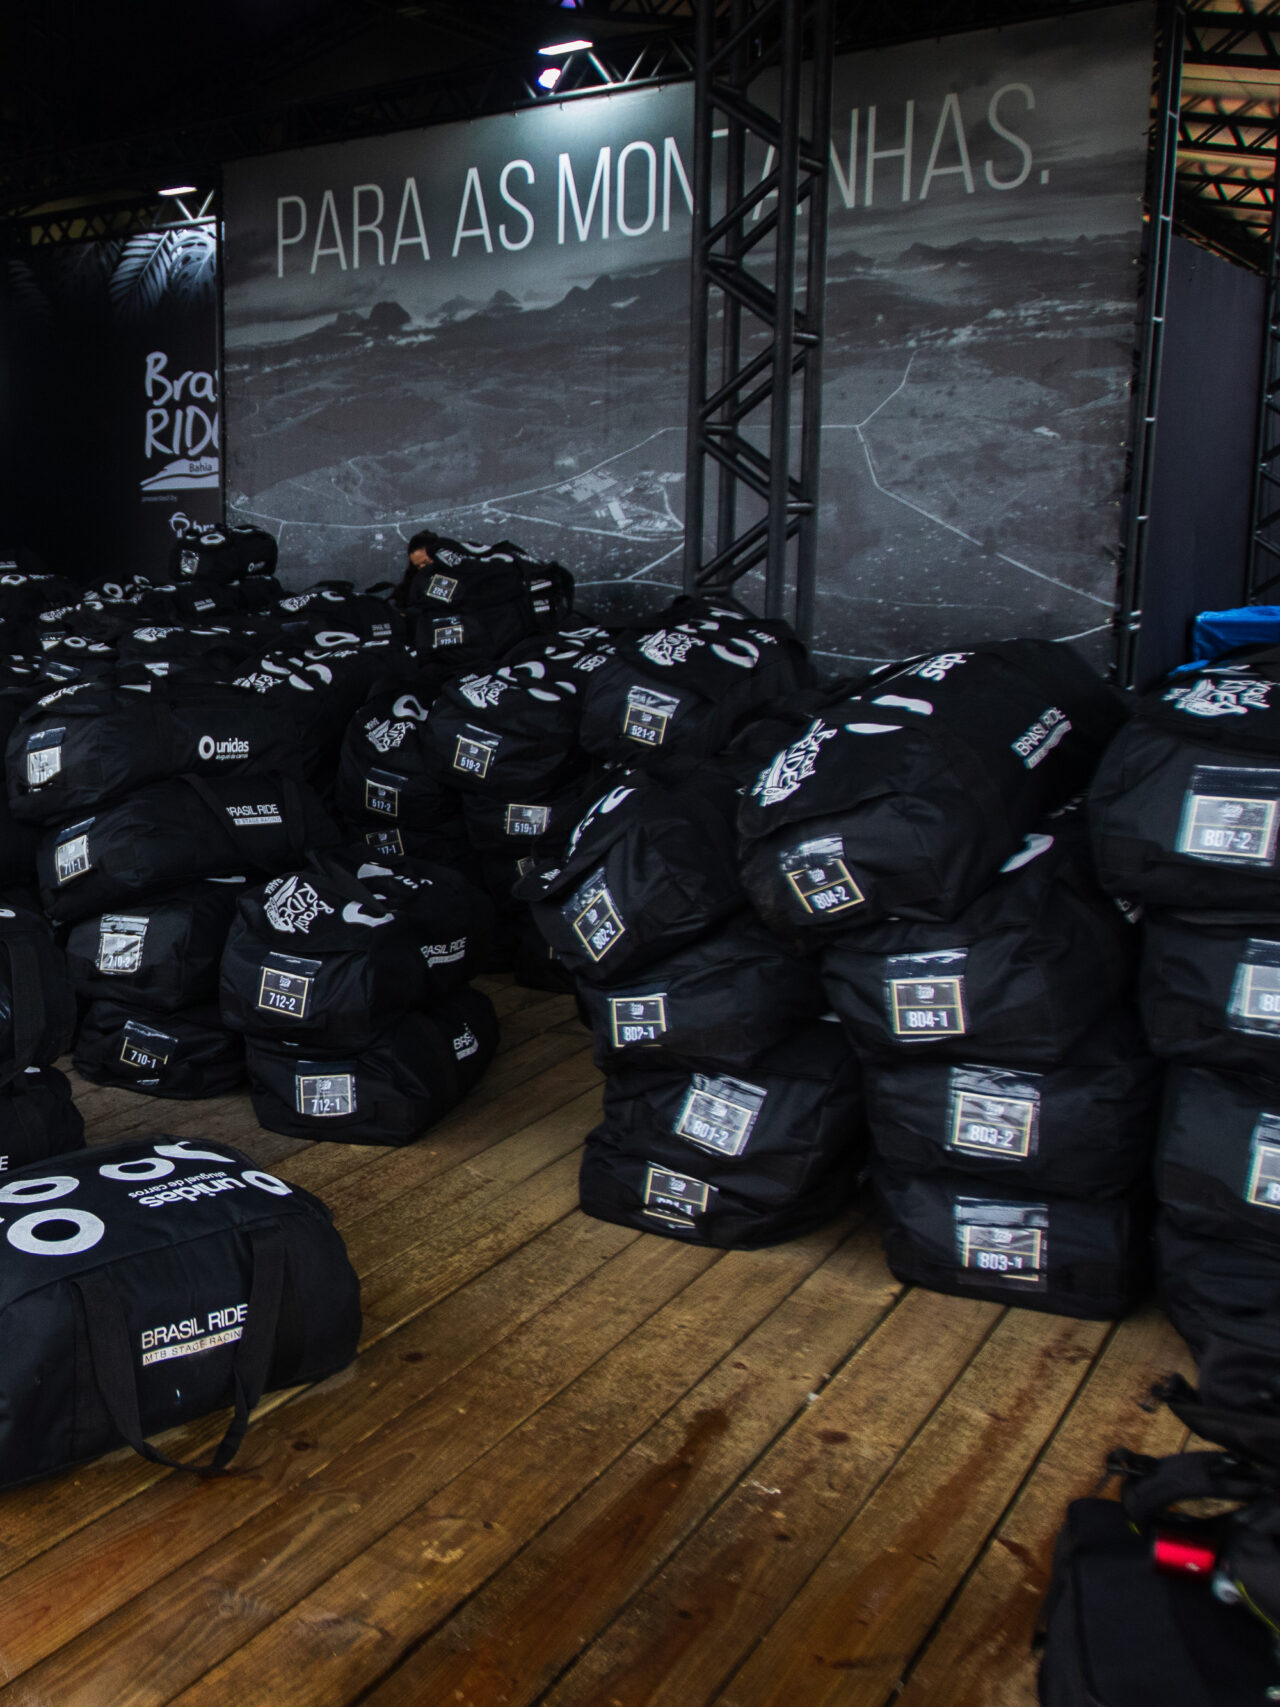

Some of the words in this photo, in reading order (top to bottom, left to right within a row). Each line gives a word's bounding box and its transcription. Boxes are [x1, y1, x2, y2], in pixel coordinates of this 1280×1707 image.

[277, 176, 431, 278] PARA
[451, 159, 535, 258] AS
[557, 83, 1051, 246] MONNHAS.
[145, 351, 219, 407] Bra
[189, 463, 213, 473] Bahia
[631, 725, 656, 741] 521-2
[216, 737, 249, 754] unidas
[257, 804, 280, 815] RIDE
[1202, 829, 1252, 849] 807-2
[377, 844, 397, 855] 17-1
[64, 858, 82, 875] 711-1
[812, 886, 850, 910] 804-2
[269, 992, 296, 1011] 712-2
[906, 1010, 949, 1028] 804-1
[130, 1050, 157, 1069] 710-1
[312, 1098, 341, 1113] 712-1
[692, 1119, 730, 1147] 801-2
[968, 1124, 1014, 1147] 803-2
[167, 1179, 184, 1188] de
[185, 1171, 228, 1186] aluguel
[127, 1184, 168, 1199] carros
[138, 1177, 247, 1208] unidas
[976, 1251, 1024, 1271] 803-1
[141, 1317, 205, 1350] BRASIL
[208, 1303, 249, 1332] RIDE
[144, 1349, 168, 1365] MTB
[171, 1341, 206, 1357] STAGE
[208, 1329, 242, 1347] RACIN
